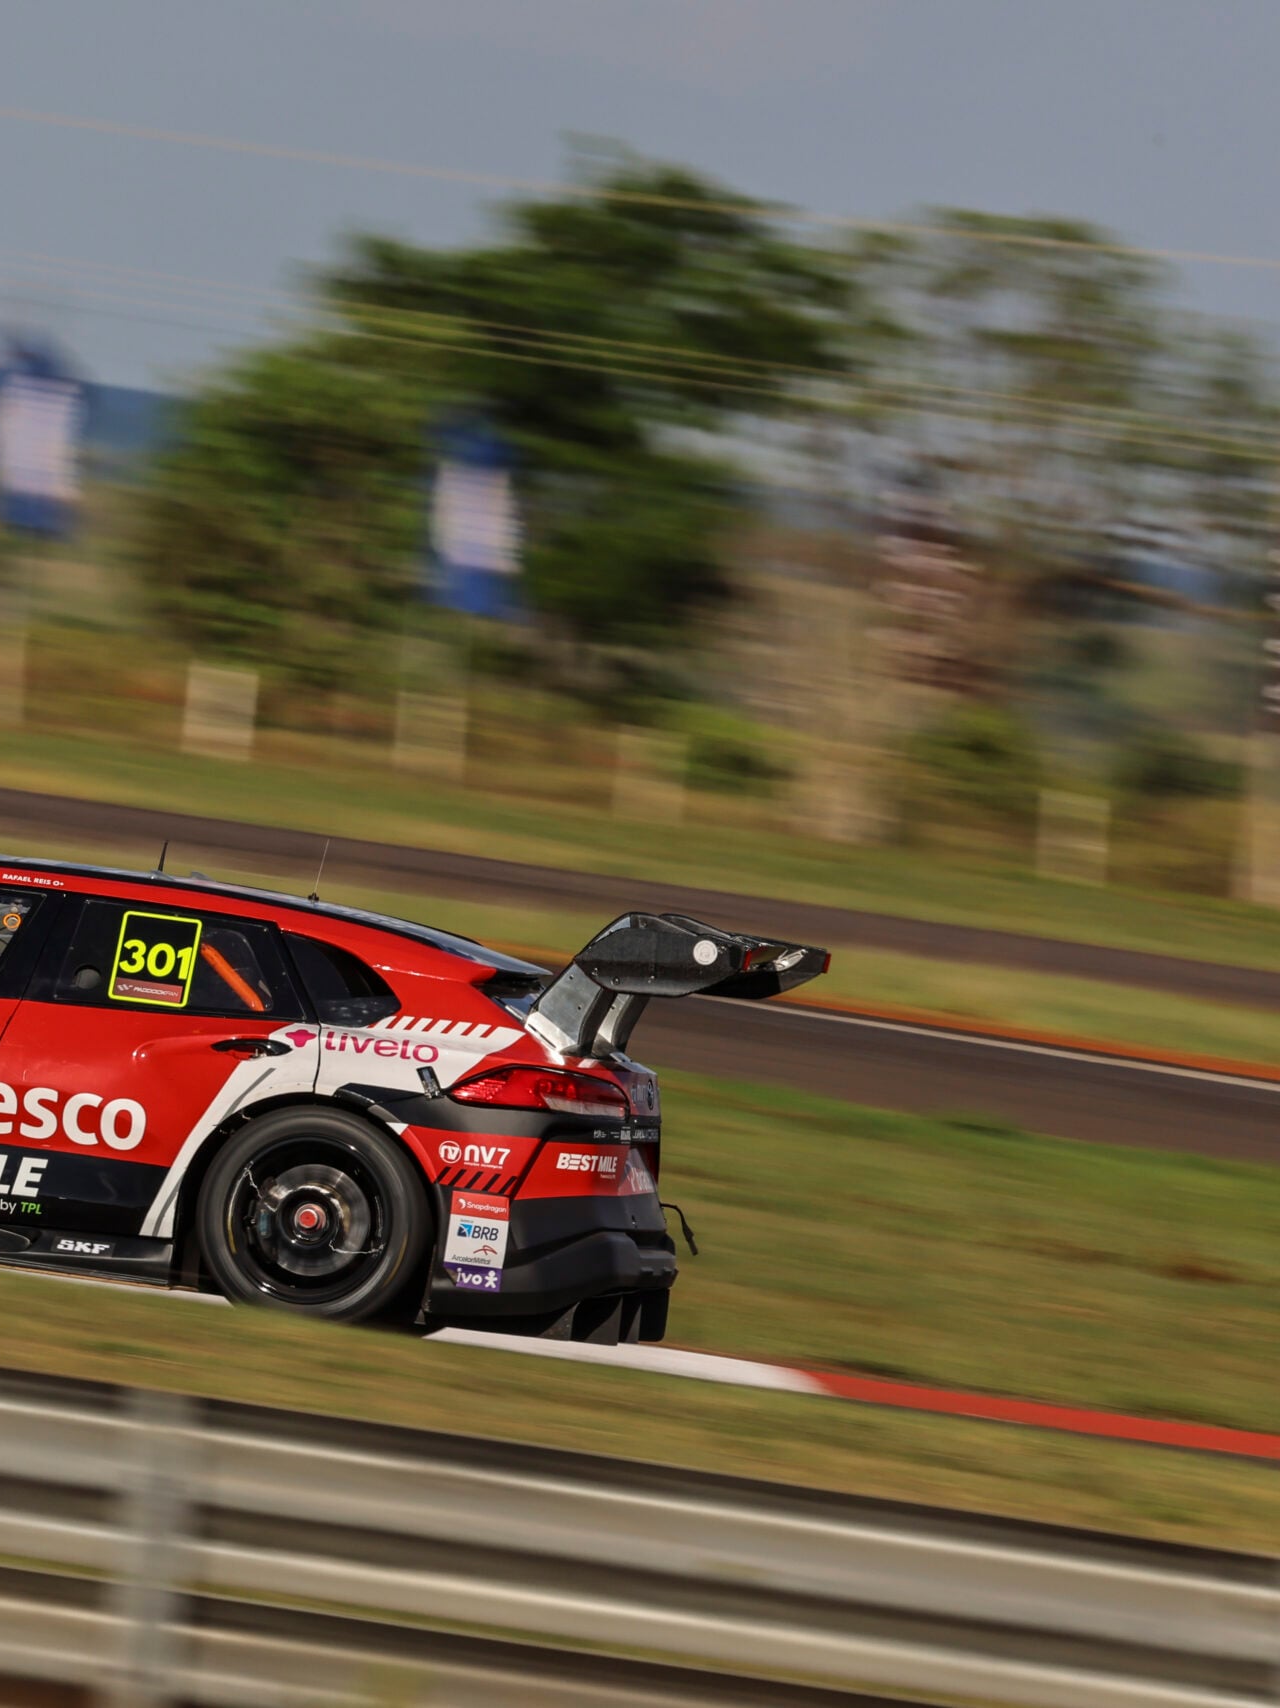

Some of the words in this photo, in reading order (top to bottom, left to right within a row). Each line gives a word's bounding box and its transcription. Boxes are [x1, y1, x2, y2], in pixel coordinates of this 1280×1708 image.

[2, 873, 32, 883] RAFAEL
[33, 877, 51, 885] REIS
[119, 939, 193, 980] 301
[324, 1031, 439, 1063] livelo
[556, 1152, 599, 1172] BEST
[597, 1156, 619, 1173] MILE
[0, 1199, 17, 1215] by
[20, 1201, 43, 1215] TPL
[466, 1201, 508, 1214] Snapdragon
[471, 1225, 500, 1242] BRB
[56, 1239, 111, 1254] SKF
[451, 1254, 491, 1266] ArcelorMittal
